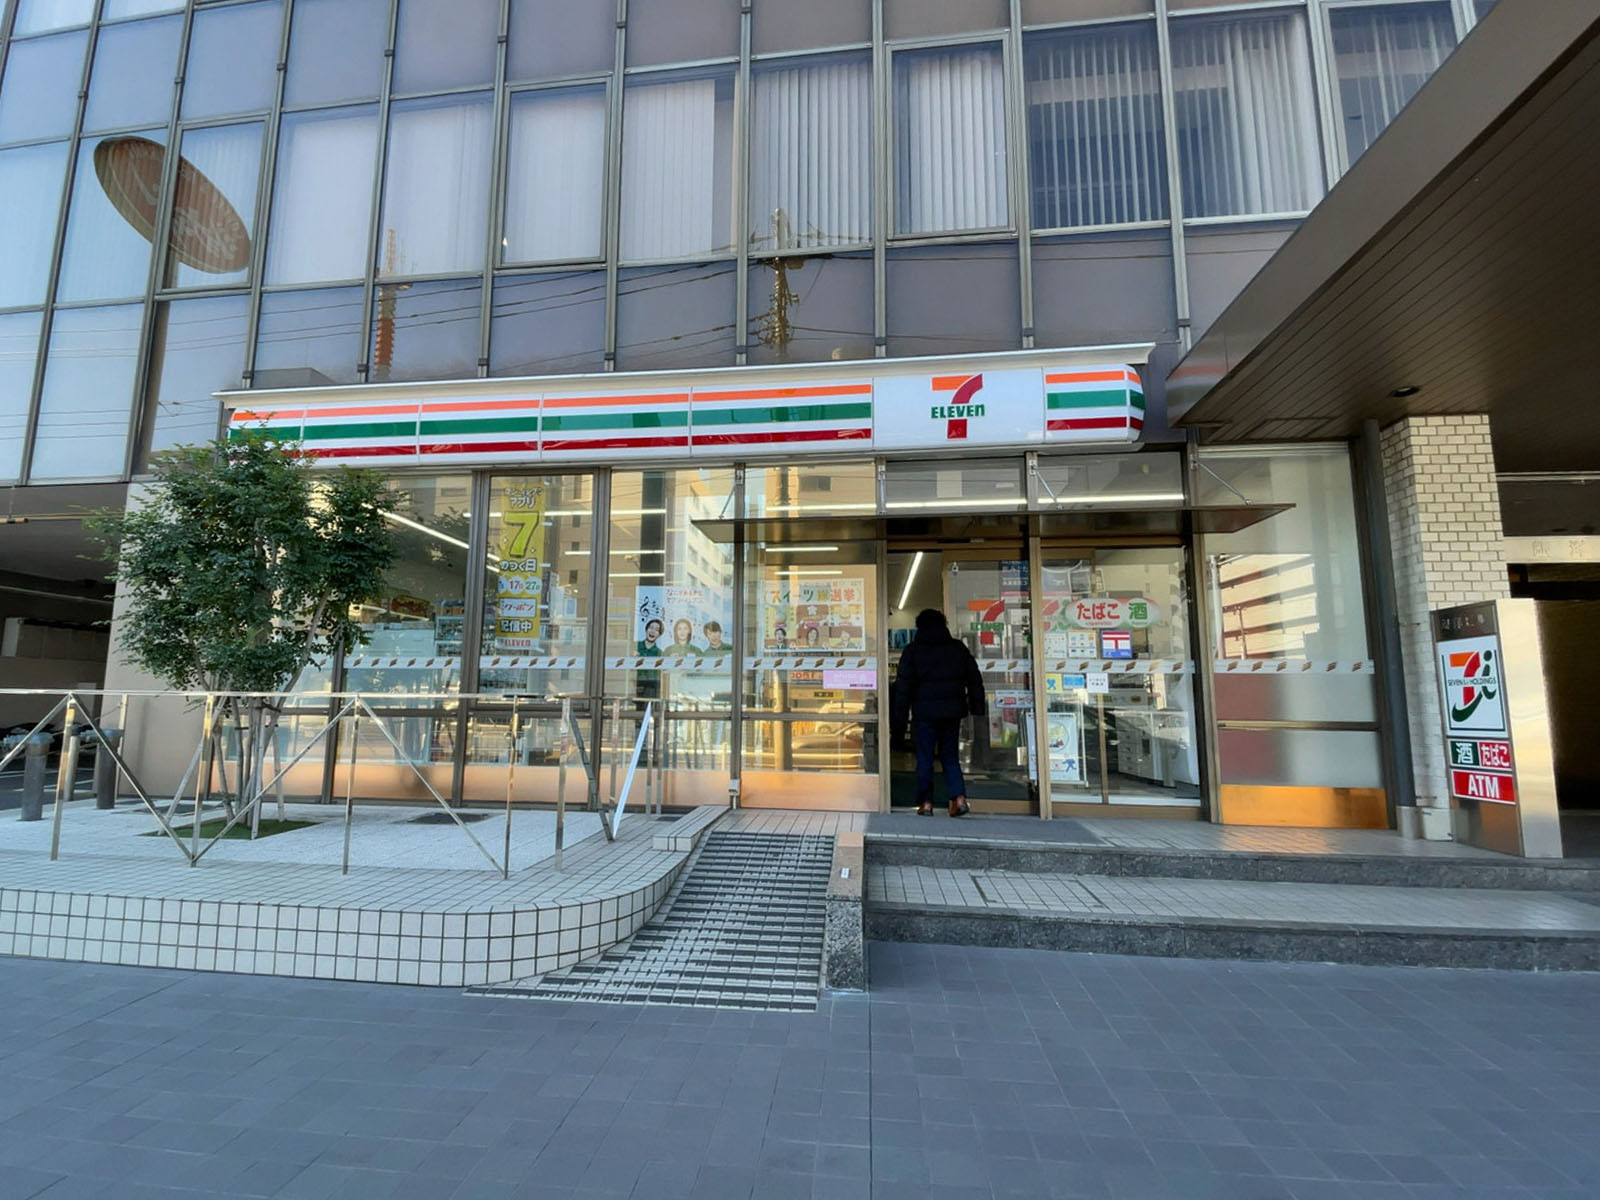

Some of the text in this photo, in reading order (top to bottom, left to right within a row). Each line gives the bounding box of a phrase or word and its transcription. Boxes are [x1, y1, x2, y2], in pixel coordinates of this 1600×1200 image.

[931, 373, 984, 439] 7
[510, 496, 535, 508] アプリ
[504, 511, 540, 558] 7
[501, 559, 537, 571] のつく日
[504, 603, 534, 612] クーポン
[1076, 602, 1148, 620] たばこ 酒
[1455, 742, 1510, 767] 酒 たばこ
[1468, 774, 1500, 798] ATM
